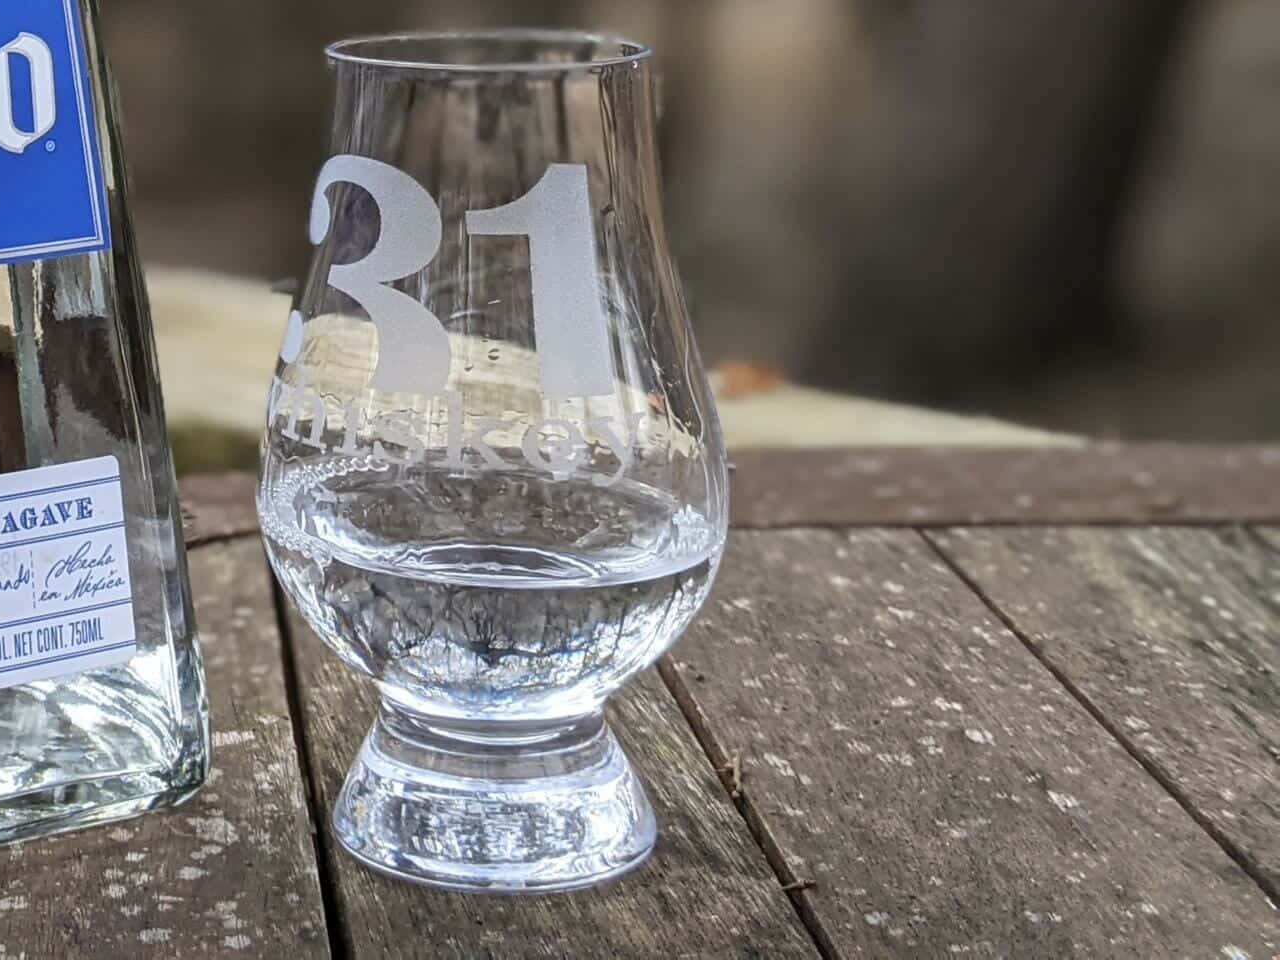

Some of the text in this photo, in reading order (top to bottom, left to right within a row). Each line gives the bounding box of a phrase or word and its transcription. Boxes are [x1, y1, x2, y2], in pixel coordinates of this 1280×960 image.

[1, 496, 94, 534] AGAVE
[14, 631, 34, 659] NET
[36, 624, 68, 654] CONT.
[69, 616, 105, 648] 750ML
